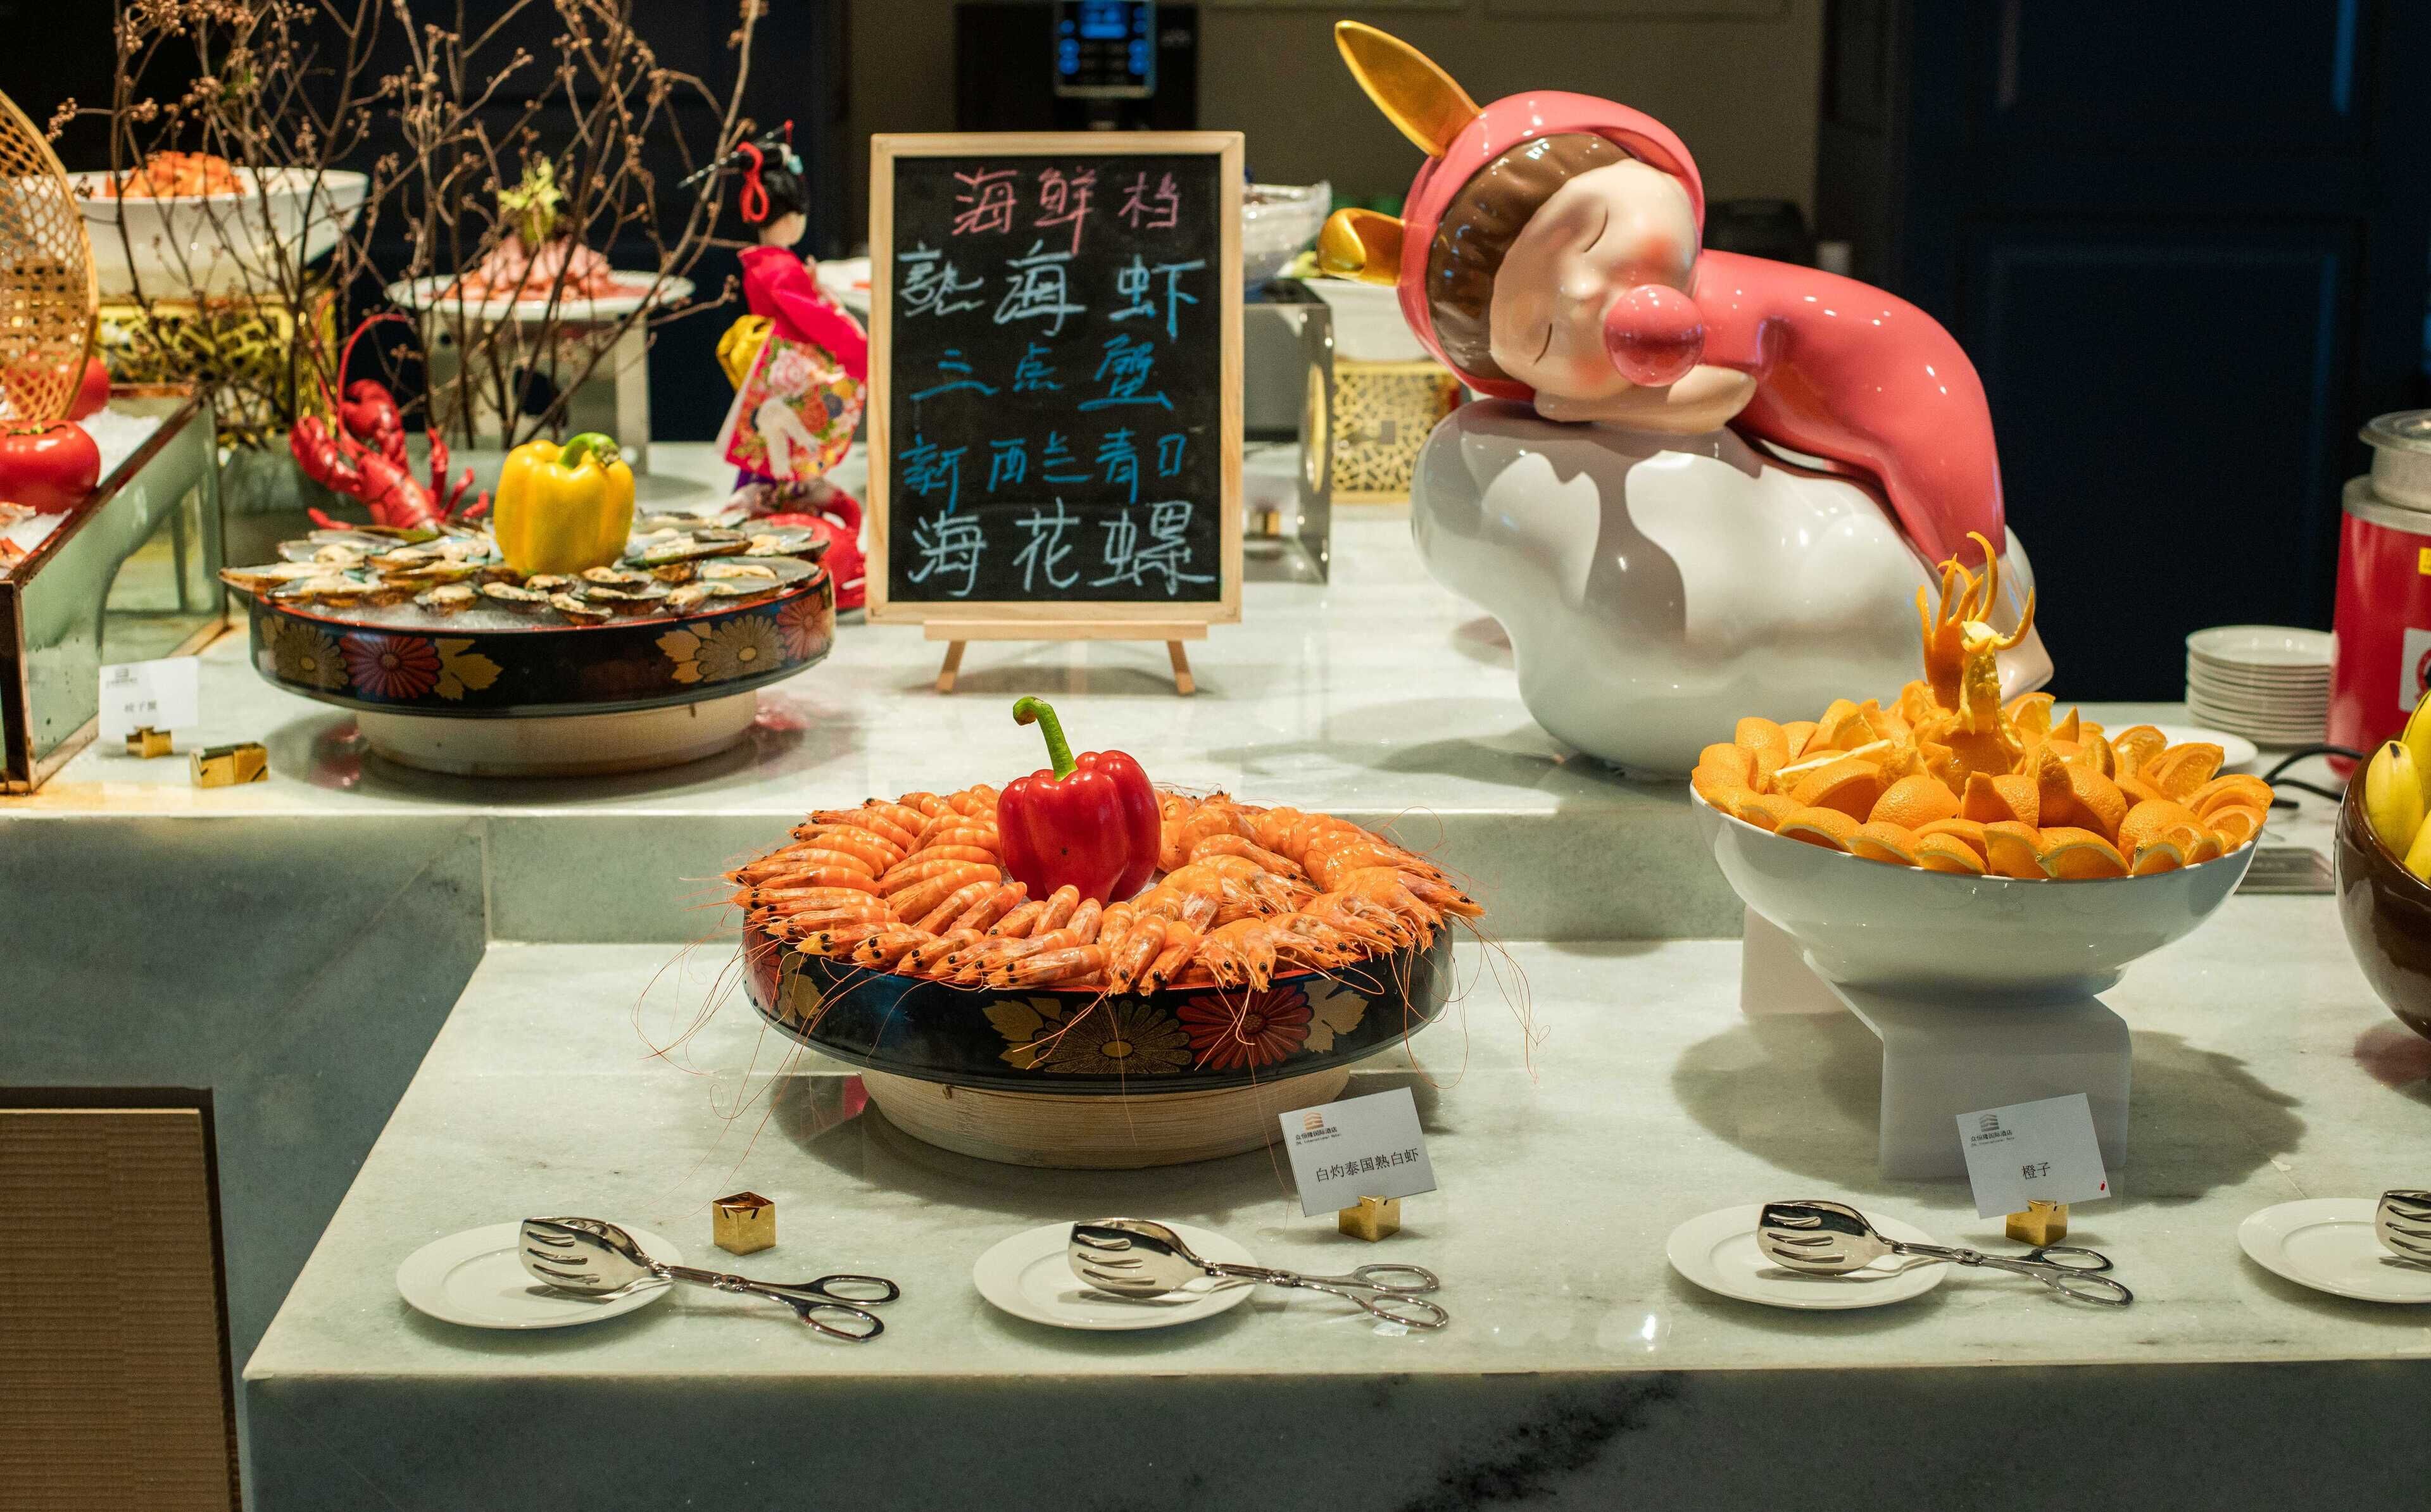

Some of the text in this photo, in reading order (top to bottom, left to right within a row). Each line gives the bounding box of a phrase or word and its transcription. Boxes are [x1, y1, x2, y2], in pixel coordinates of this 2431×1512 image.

[952, 167, 1179, 254] 海鲜档
[907, 497, 1217, 597] 海花螺
[1316, 1148, 1419, 1182] 白灼泰国熟白虾
[2021, 1162, 2051, 1180] 橙子
